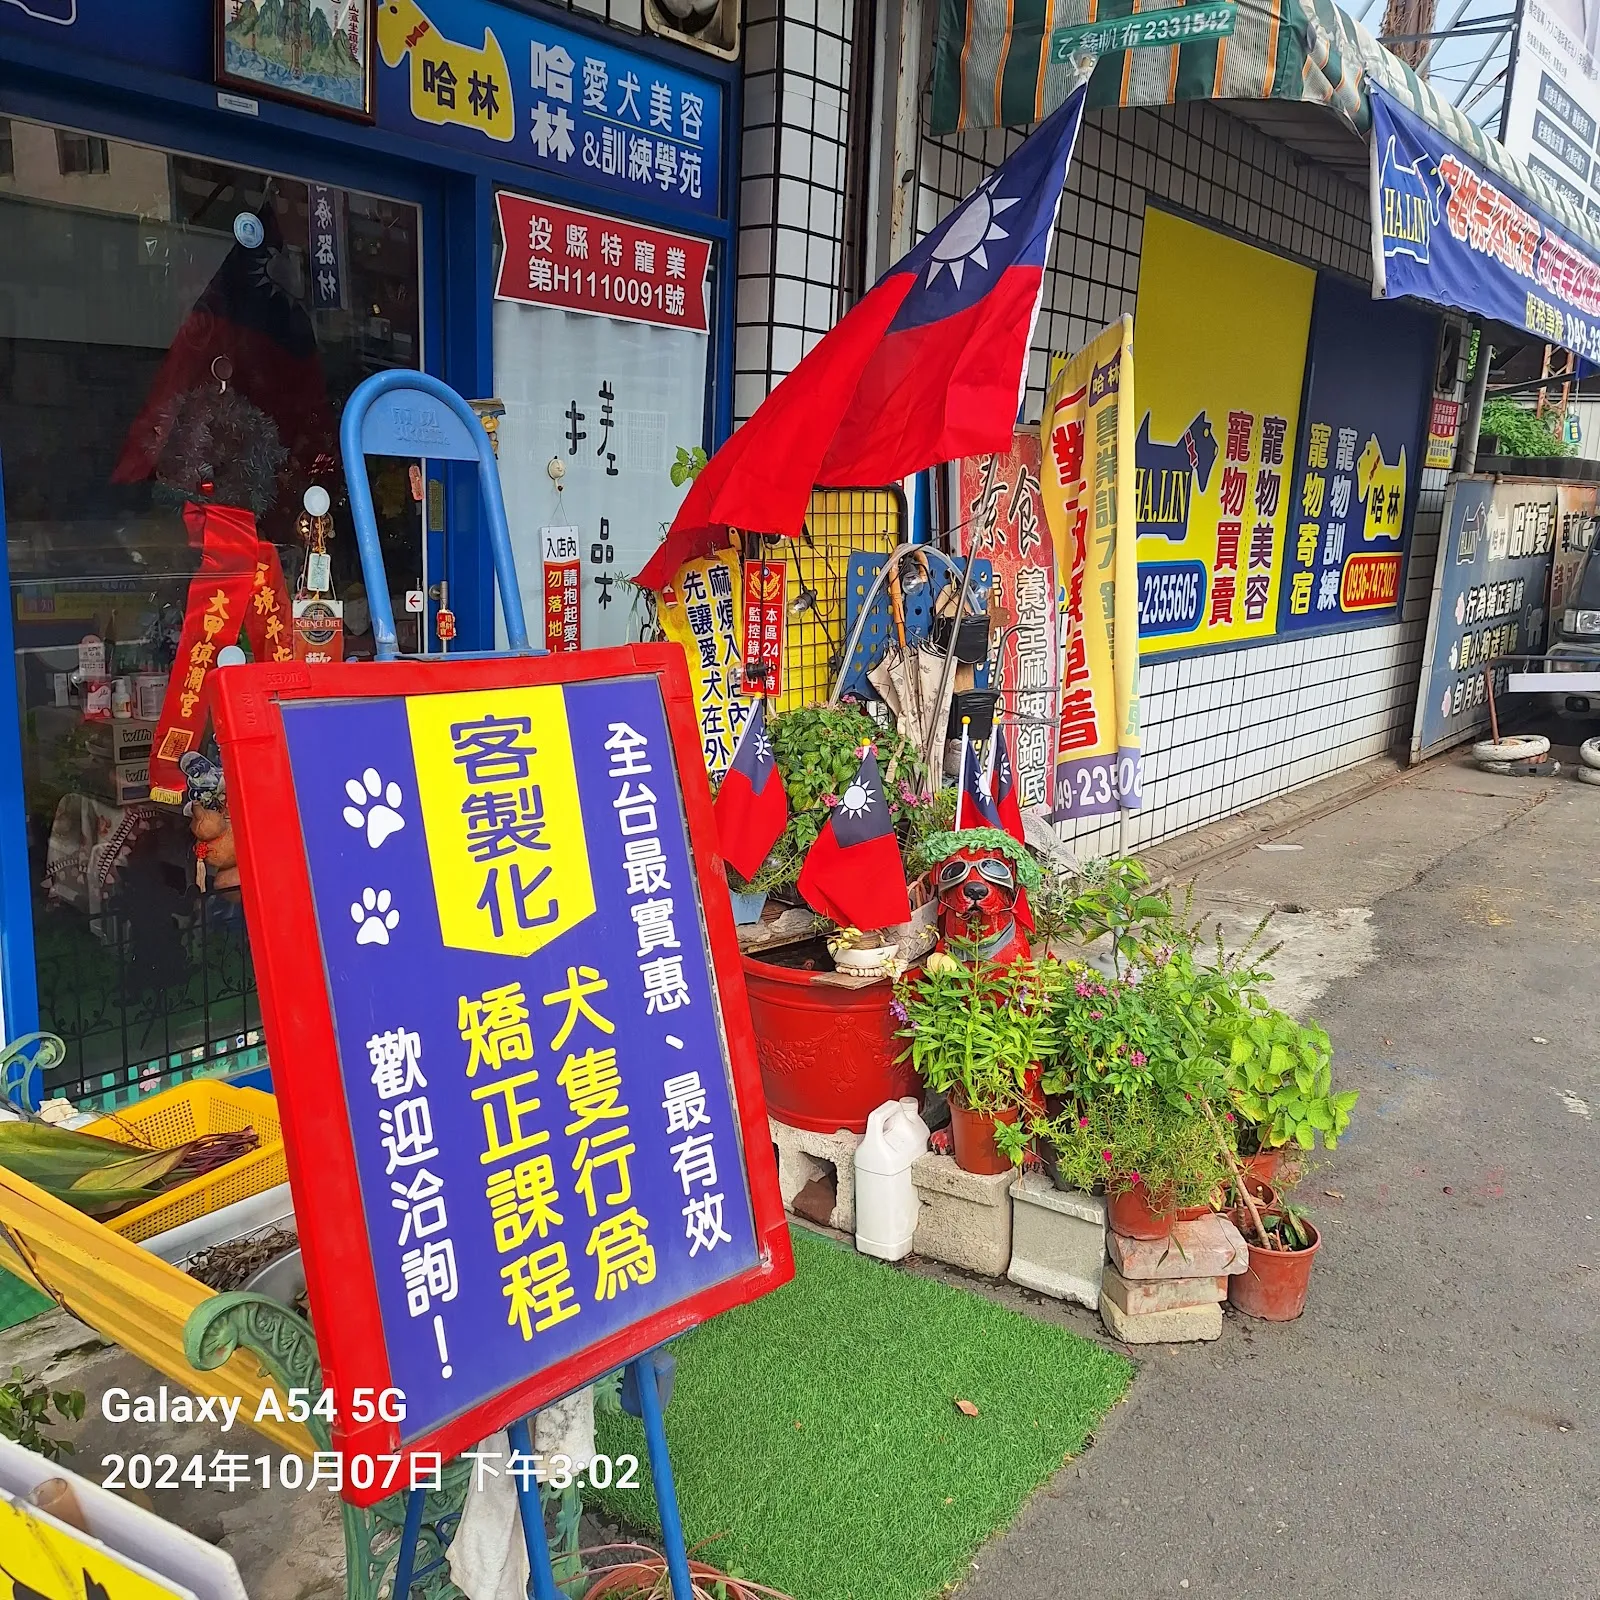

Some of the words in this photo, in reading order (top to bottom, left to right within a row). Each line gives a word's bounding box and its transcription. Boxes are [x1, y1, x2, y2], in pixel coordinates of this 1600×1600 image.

[1144, 9, 1231, 41] 2331542
[423, 59, 499, 120] 哈林
[530, 40, 576, 163] 哈林
[582, 56, 704, 141] 愛犬美容
[582, 126, 702, 199] &訓練學苑
[528, 255, 685, 316] 第H1110091號
[529, 215, 687, 279] 投縣特寵業
[1092, 364, 1120, 396] 哈林
[1208, 410, 1254, 628] 寵物買賣
[1245, 415, 1287, 622] 寵物美容
[1290, 422, 1332, 615] 寵物寄宿
[1317, 427, 1358, 611] 寵物訓練
[1370, 484, 1401, 524] 哈林
[546, 537, 577, 558] 入店內
[449, 714, 560, 938] 客製化
[603, 722, 733, 1258] 全台最實惠、最有效
[457, 981, 581, 1342] 矯正課程
